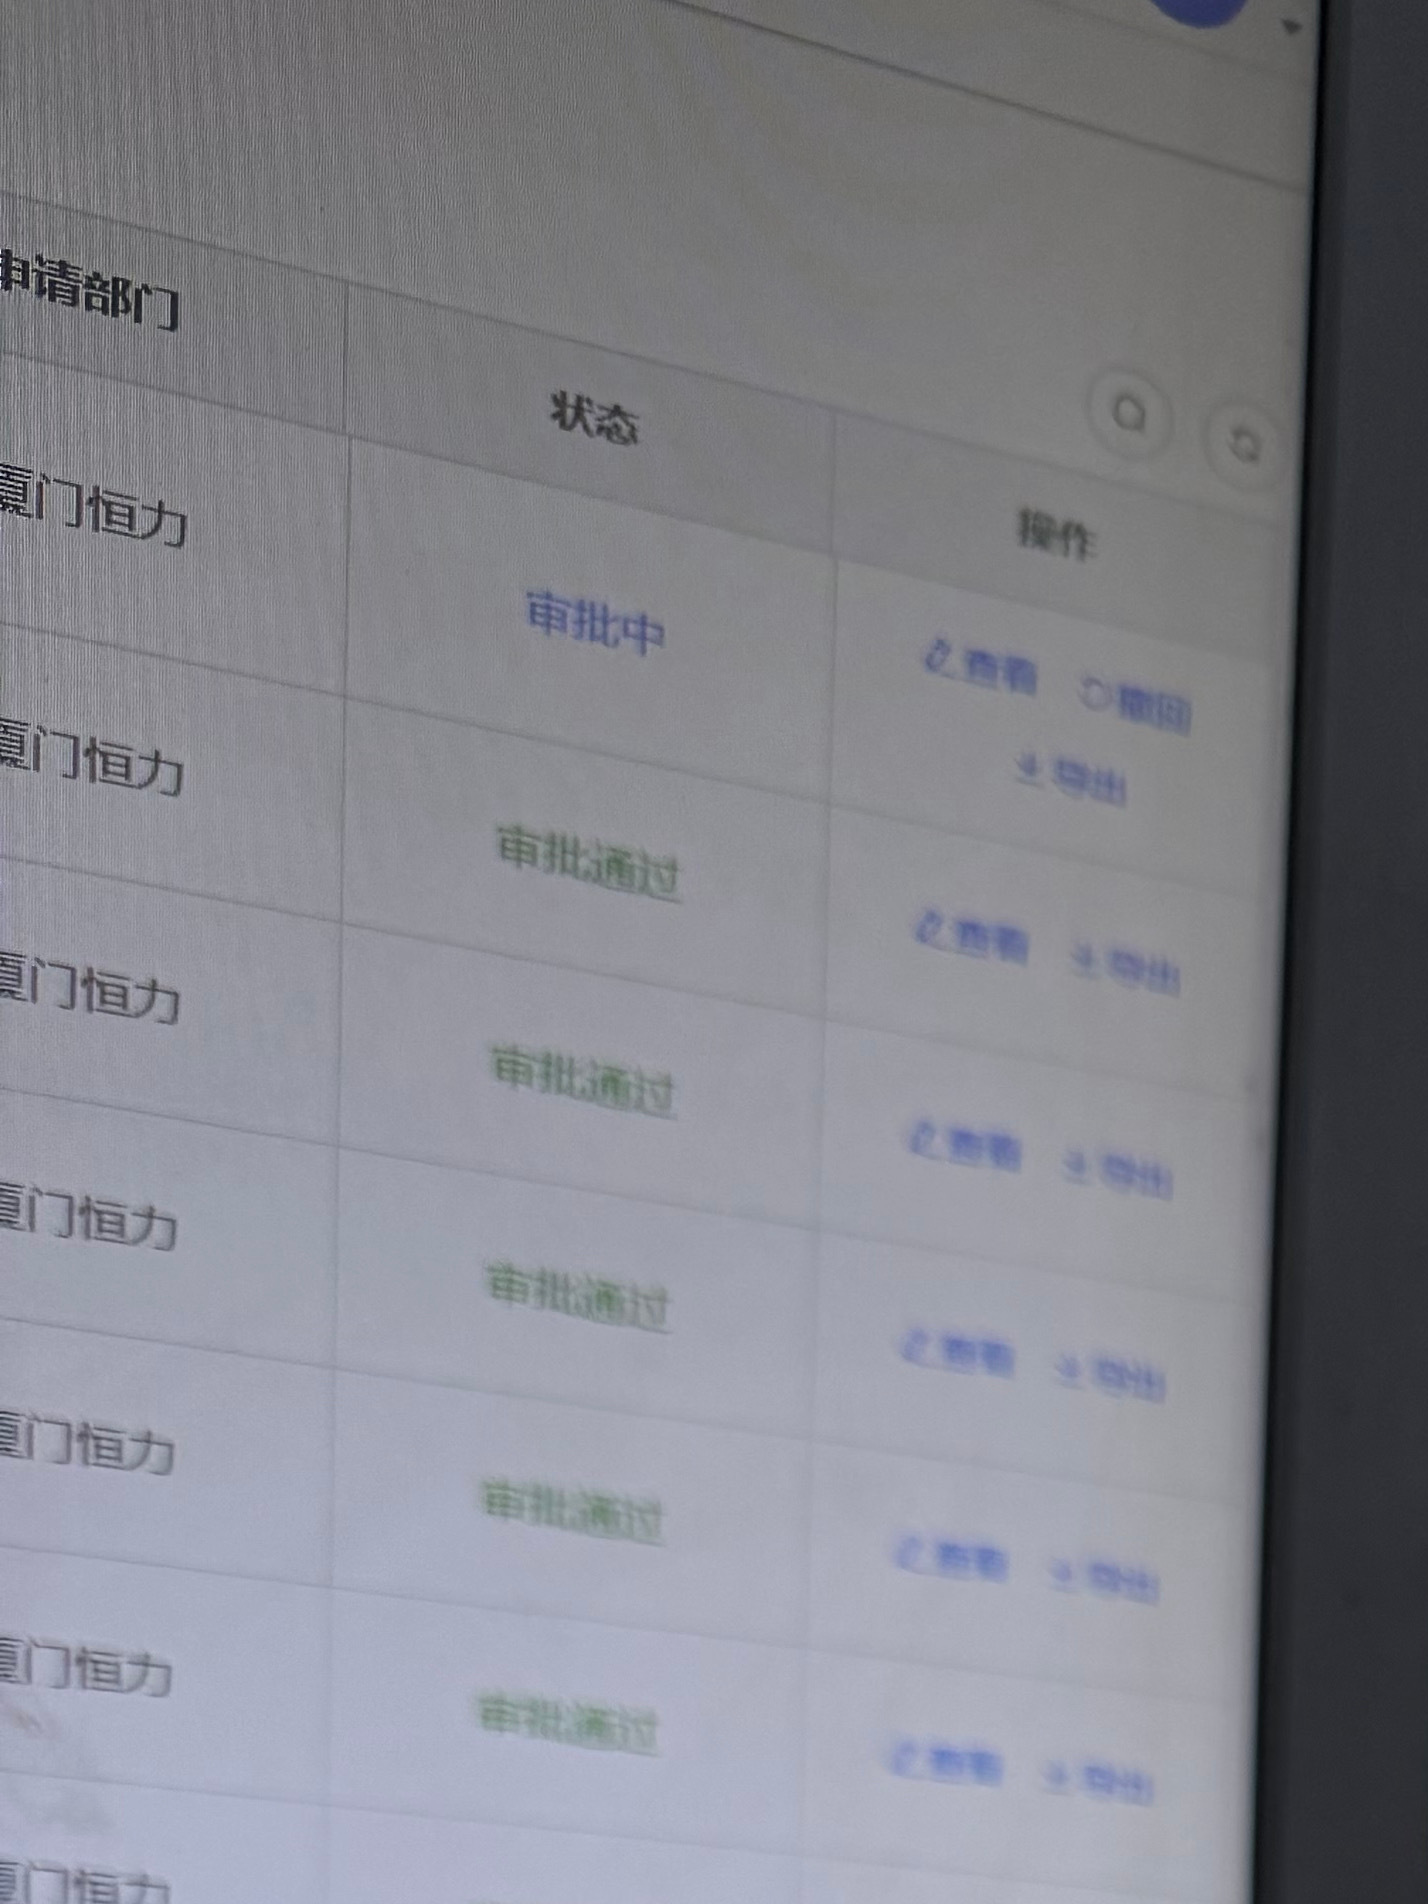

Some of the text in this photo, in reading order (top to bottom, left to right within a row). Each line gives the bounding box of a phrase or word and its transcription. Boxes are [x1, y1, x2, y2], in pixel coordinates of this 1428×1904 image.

[550, 390, 641, 446] 状态
[526, 588, 666, 657] 审批中
[498, 826, 683, 902] 审批通过
